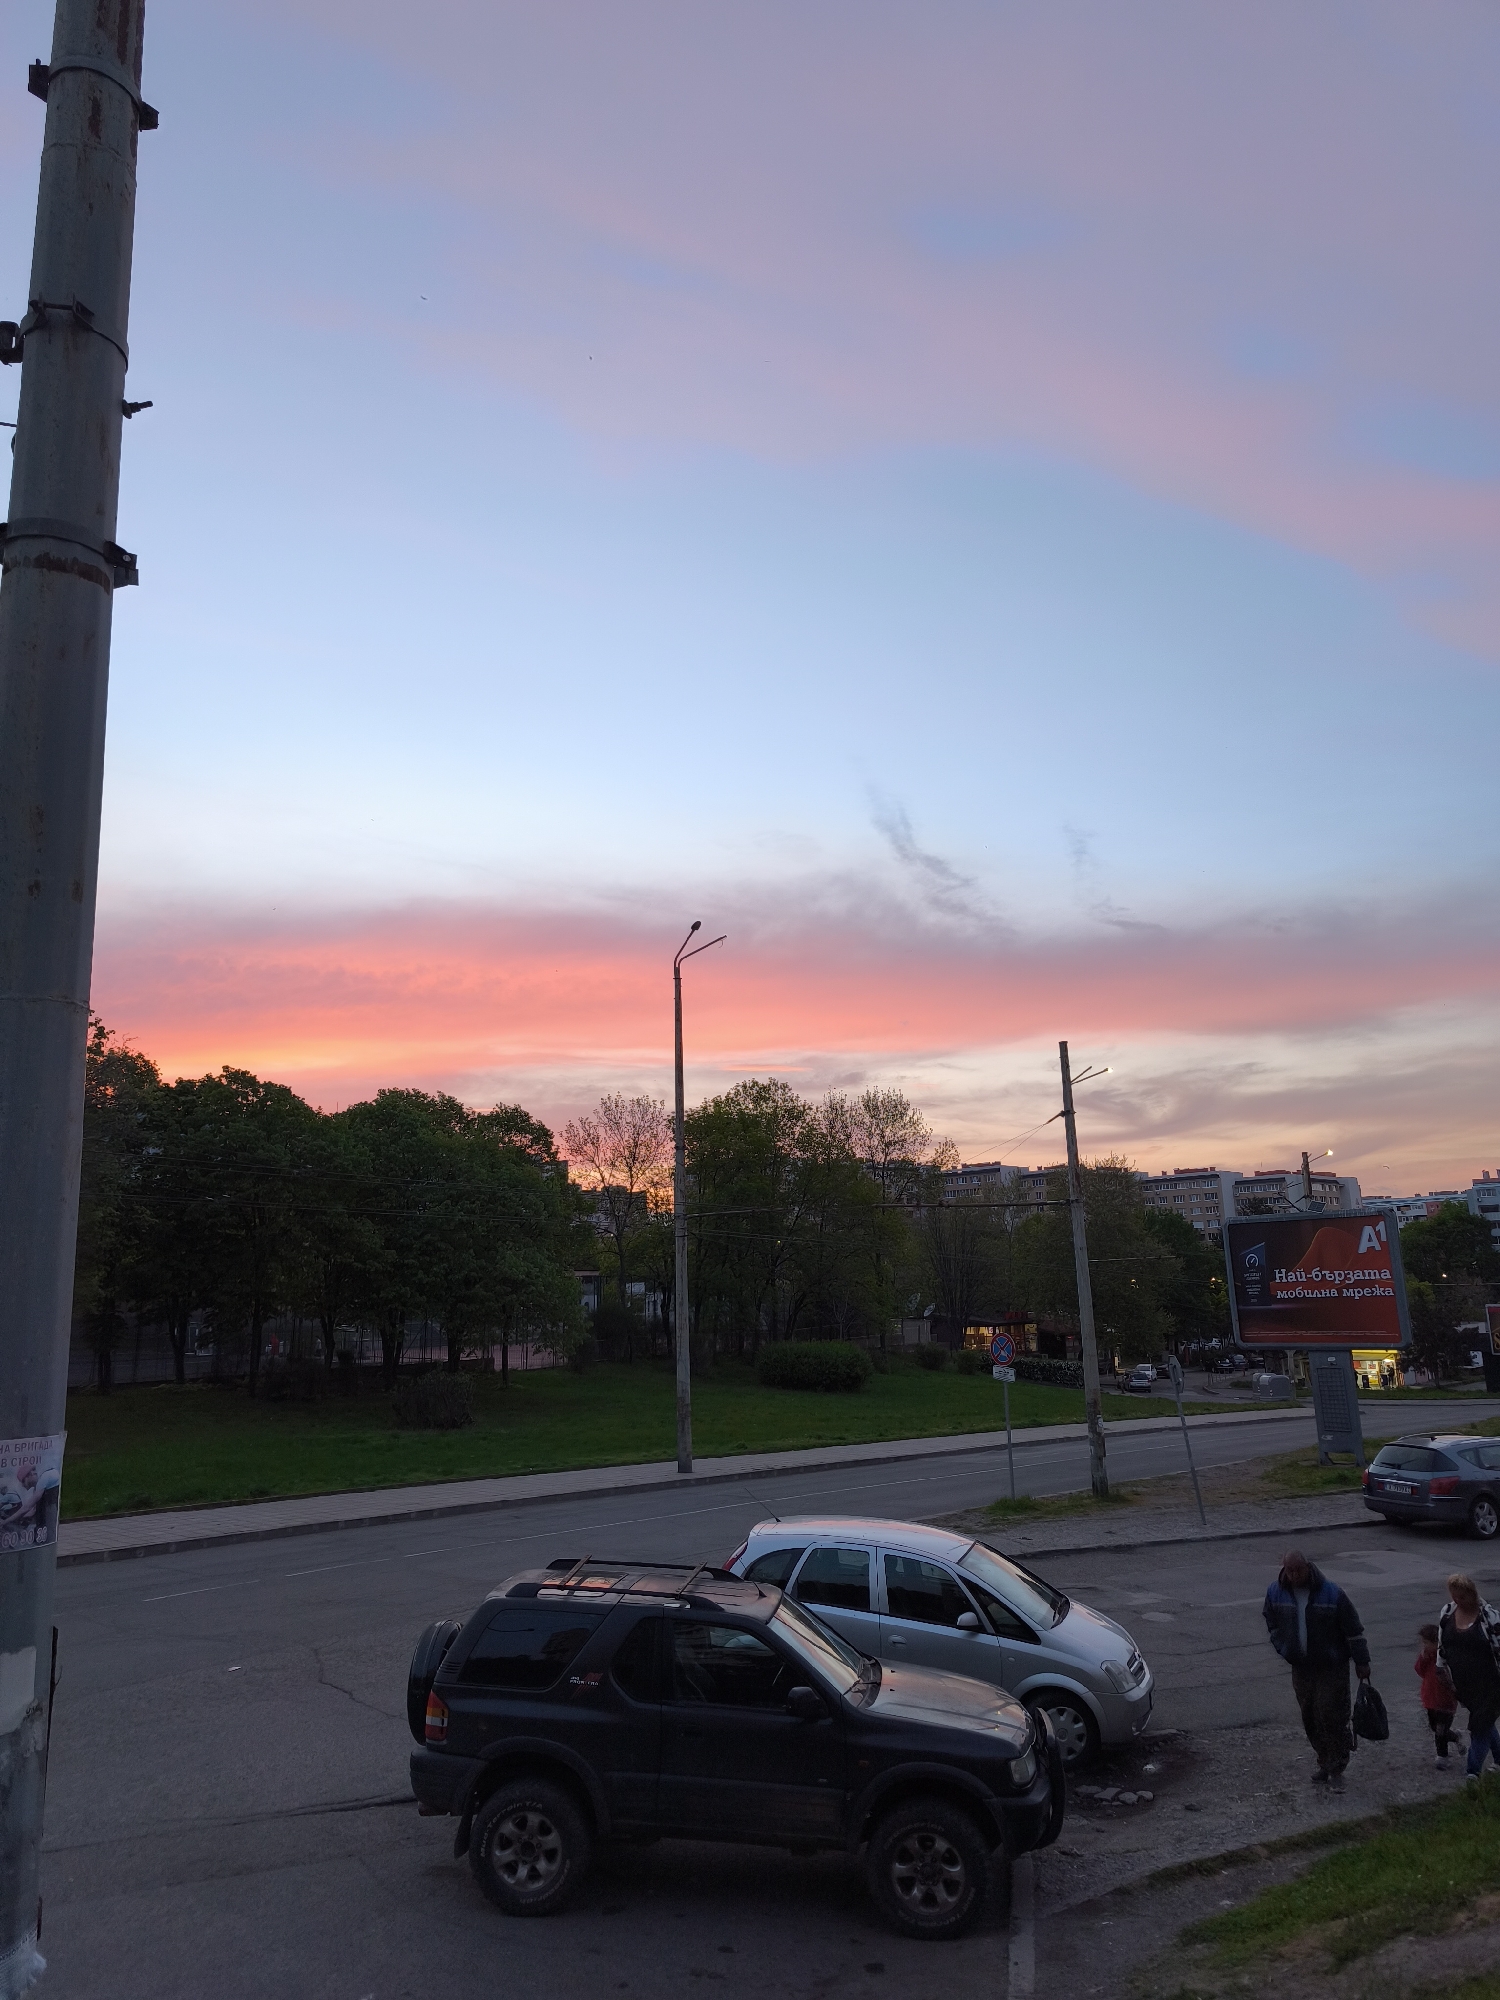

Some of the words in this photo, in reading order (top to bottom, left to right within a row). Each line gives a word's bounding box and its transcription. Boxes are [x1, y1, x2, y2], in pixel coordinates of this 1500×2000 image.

[1358, 1220, 1387, 1254] A1
[1274, 1267, 1392, 1284] Най-бързата
[1276, 1286, 1339, 1299] мобилна
[1342, 1285, 1395, 1300] мрежа
